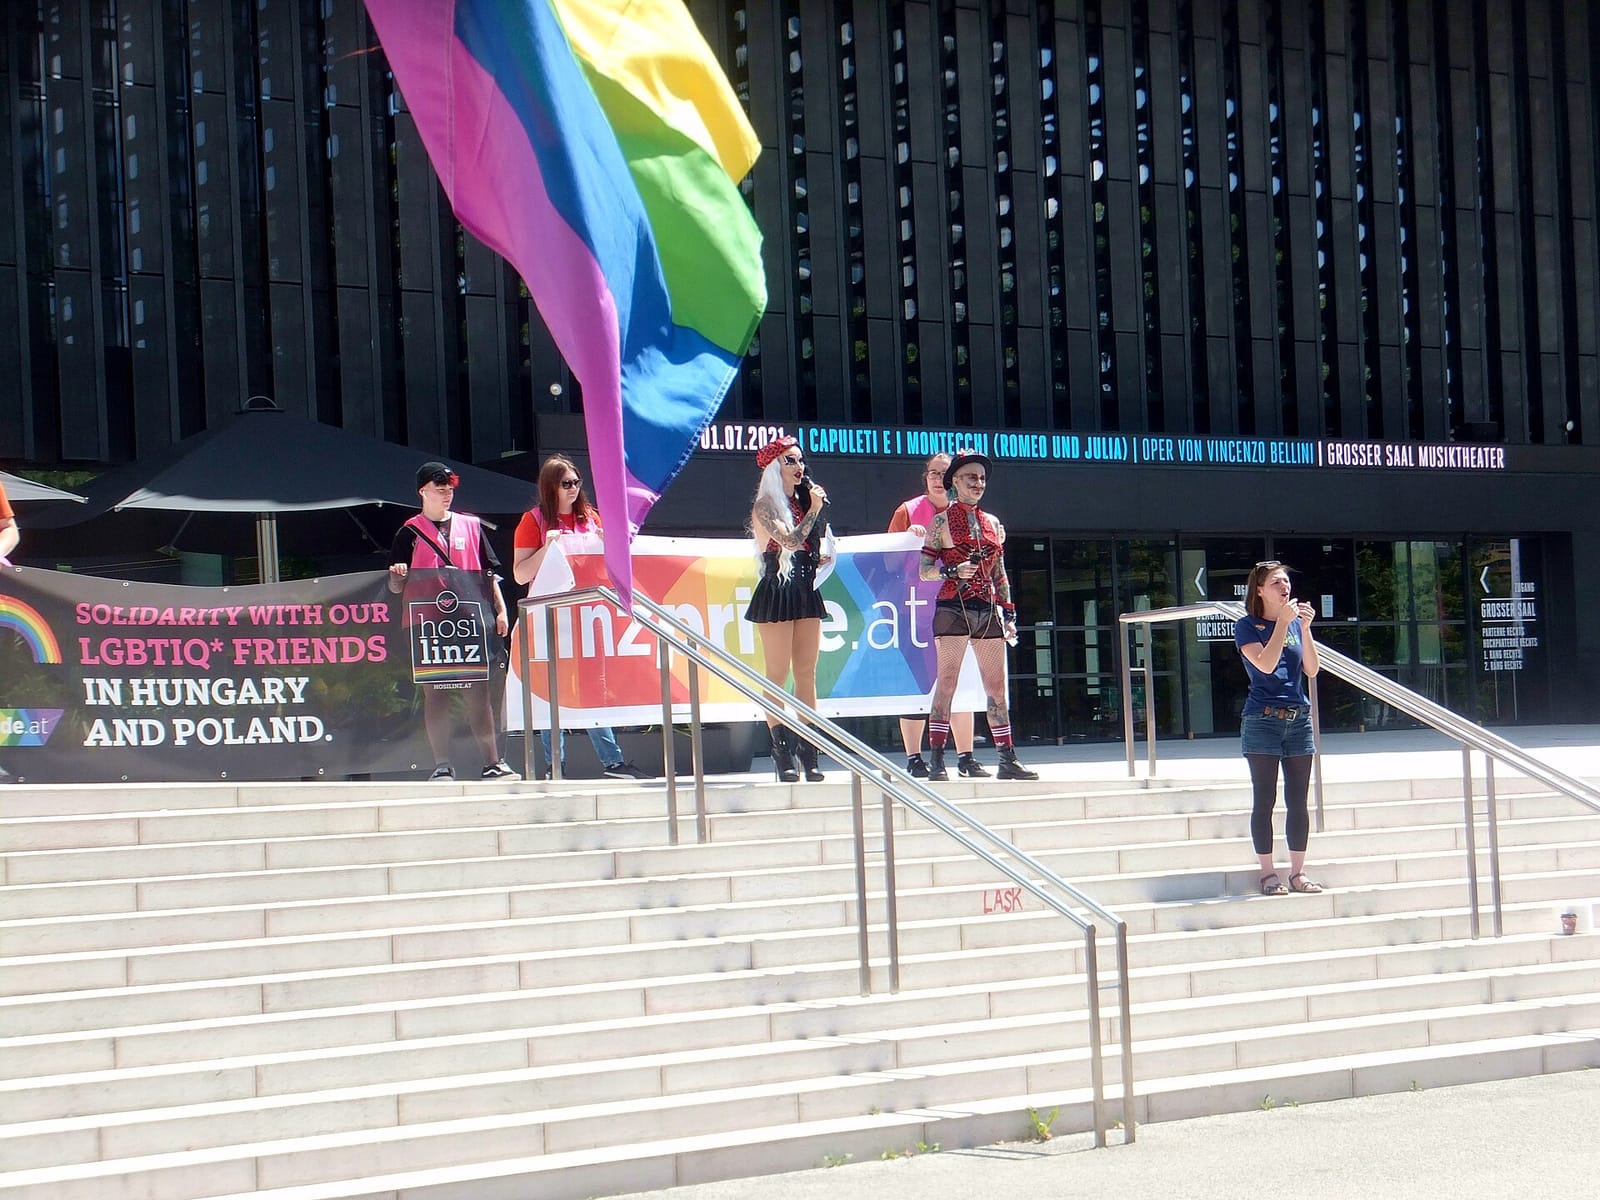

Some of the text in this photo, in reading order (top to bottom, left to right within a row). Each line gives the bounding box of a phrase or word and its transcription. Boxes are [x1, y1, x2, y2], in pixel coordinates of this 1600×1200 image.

[809, 427, 878, 454] CAPULETI
[883, 430, 891, 454] E
[906, 431, 988, 457] MONTECCHI
[993, 433, 1047, 458] (ROMEO
[1052, 435, 1080, 459] UND
[1084, 436, 1127, 461] JULIA)
[1142, 438, 1174, 461] OPER
[1177, 439, 1202, 462] VON
[1206, 439, 1266, 463] VINCENZO
[1270, 441, 1314, 464] BELLINI
[1327, 442, 1382, 466] GROSSER
[1385, 444, 1415, 467] SAAL
[1418, 445, 1505, 469] MUSIKTHEATER
[75, 602, 390, 626] SOLIDARITY WITH OUR
[1481, 602, 1537, 618] GROSSER SAAL
[418, 613, 480, 639] hosi
[530, 586, 929, 669] linzprie.at
[1196, 622, 1236, 637] ORCHESTE
[232, 635, 388, 665] FRIENDS
[420, 639, 480, 665] linz
[82, 676, 309, 706] IN HUNGARY
[83, 716, 334, 747] AND POLAND.
[983, 887, 1023, 914] LASK
